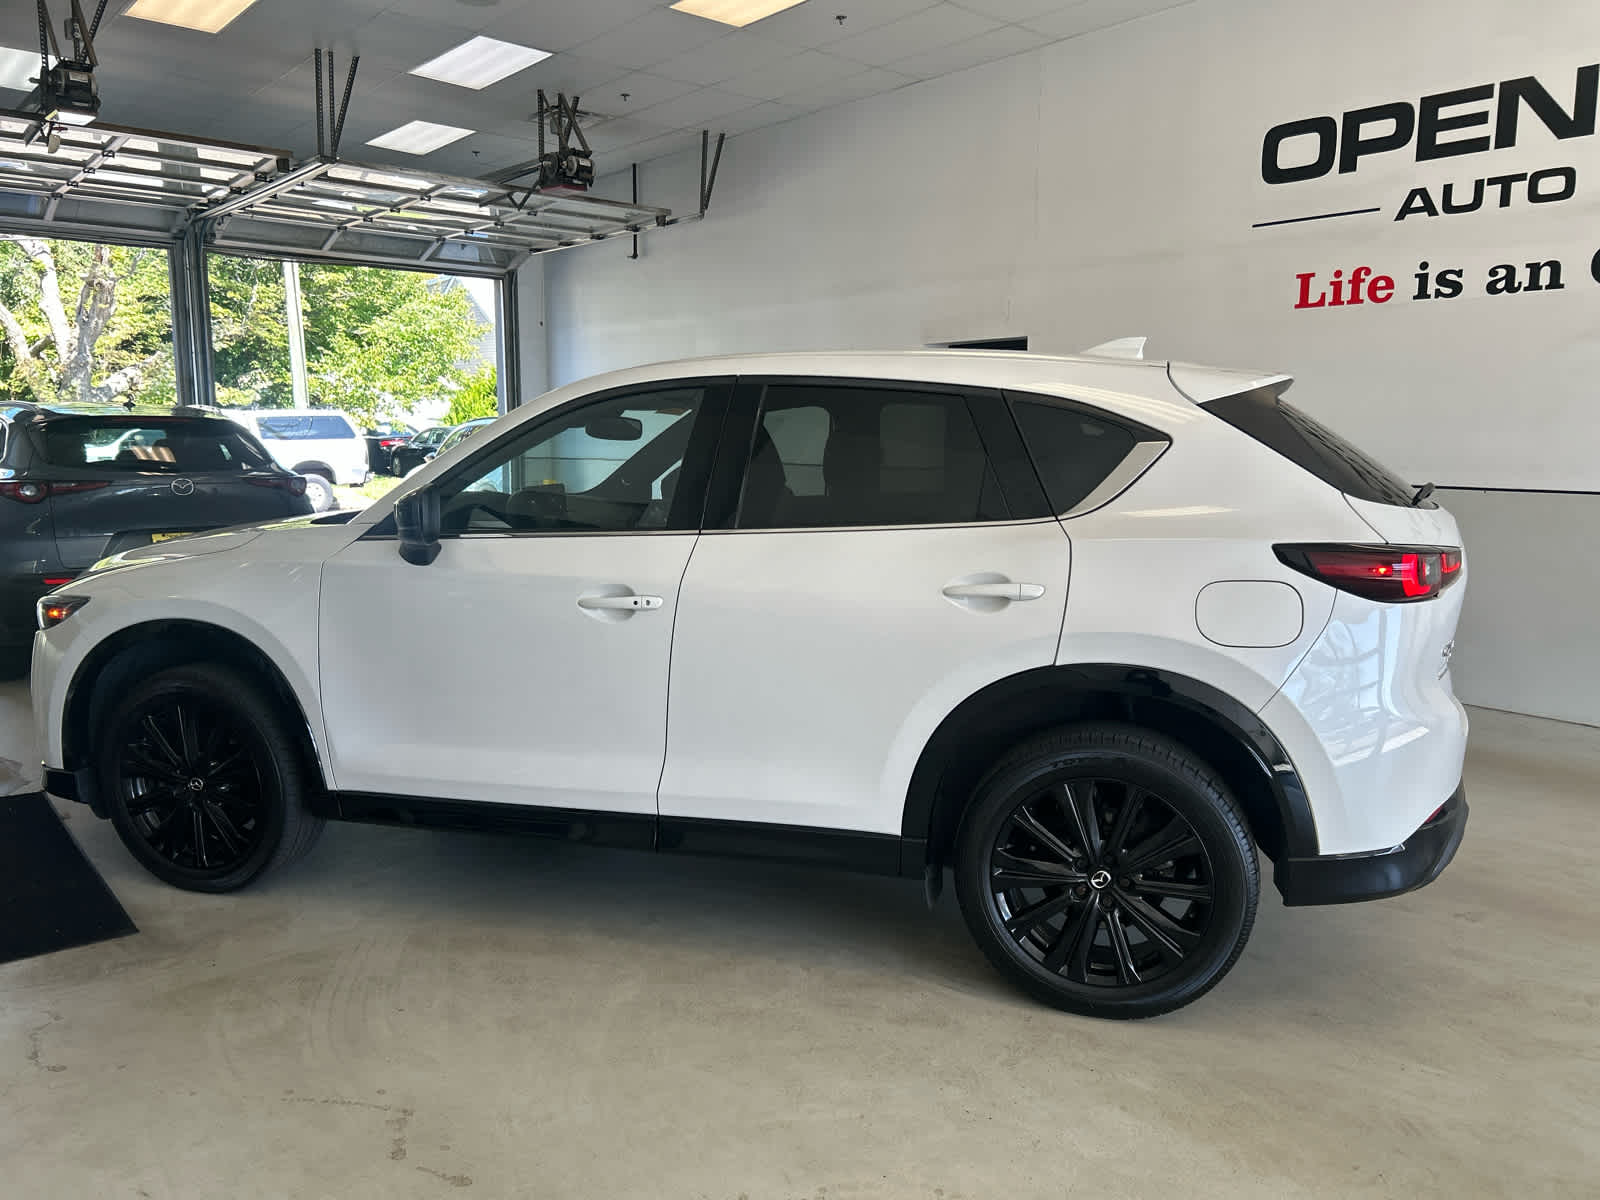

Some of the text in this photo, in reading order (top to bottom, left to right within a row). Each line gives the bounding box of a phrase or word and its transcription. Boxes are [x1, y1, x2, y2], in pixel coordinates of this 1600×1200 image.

[1261, 63, 1600, 185] OPEN
[1393, 166, 1577, 222] AUTO
[1294, 266, 1395, 310] Life
[1412, 260, 1464, 301] is
[1485, 259, 1565, 296] an
